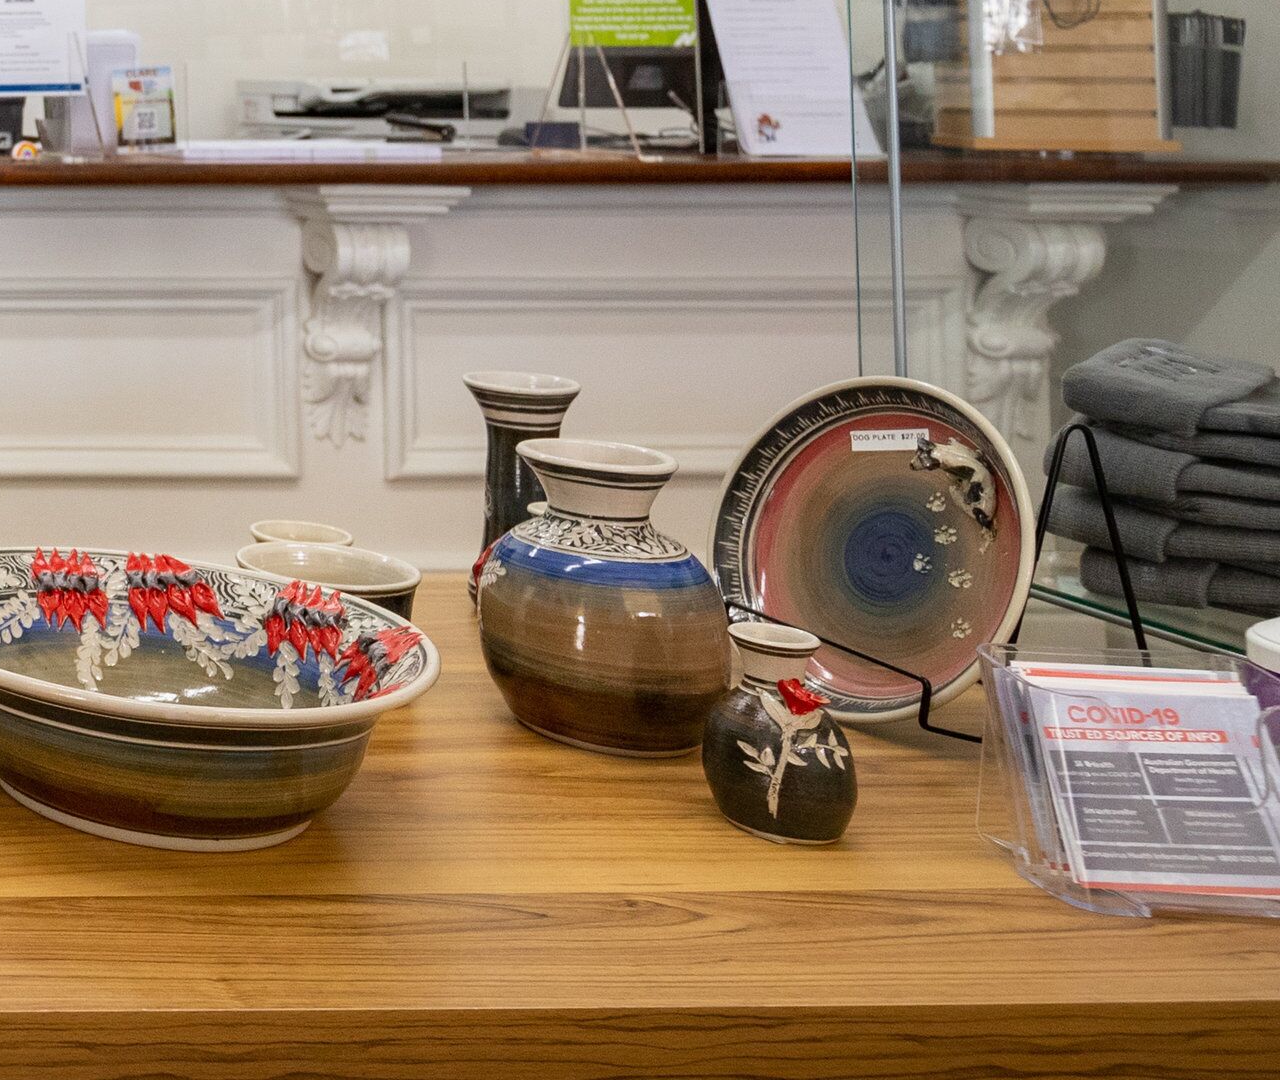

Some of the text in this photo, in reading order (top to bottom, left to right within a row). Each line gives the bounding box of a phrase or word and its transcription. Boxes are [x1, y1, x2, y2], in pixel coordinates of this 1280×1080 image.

[1067, 705, 1180, 726] COVID-19
[1049, 728, 1221, 743] TRUSTED SOURCES OF INFO
